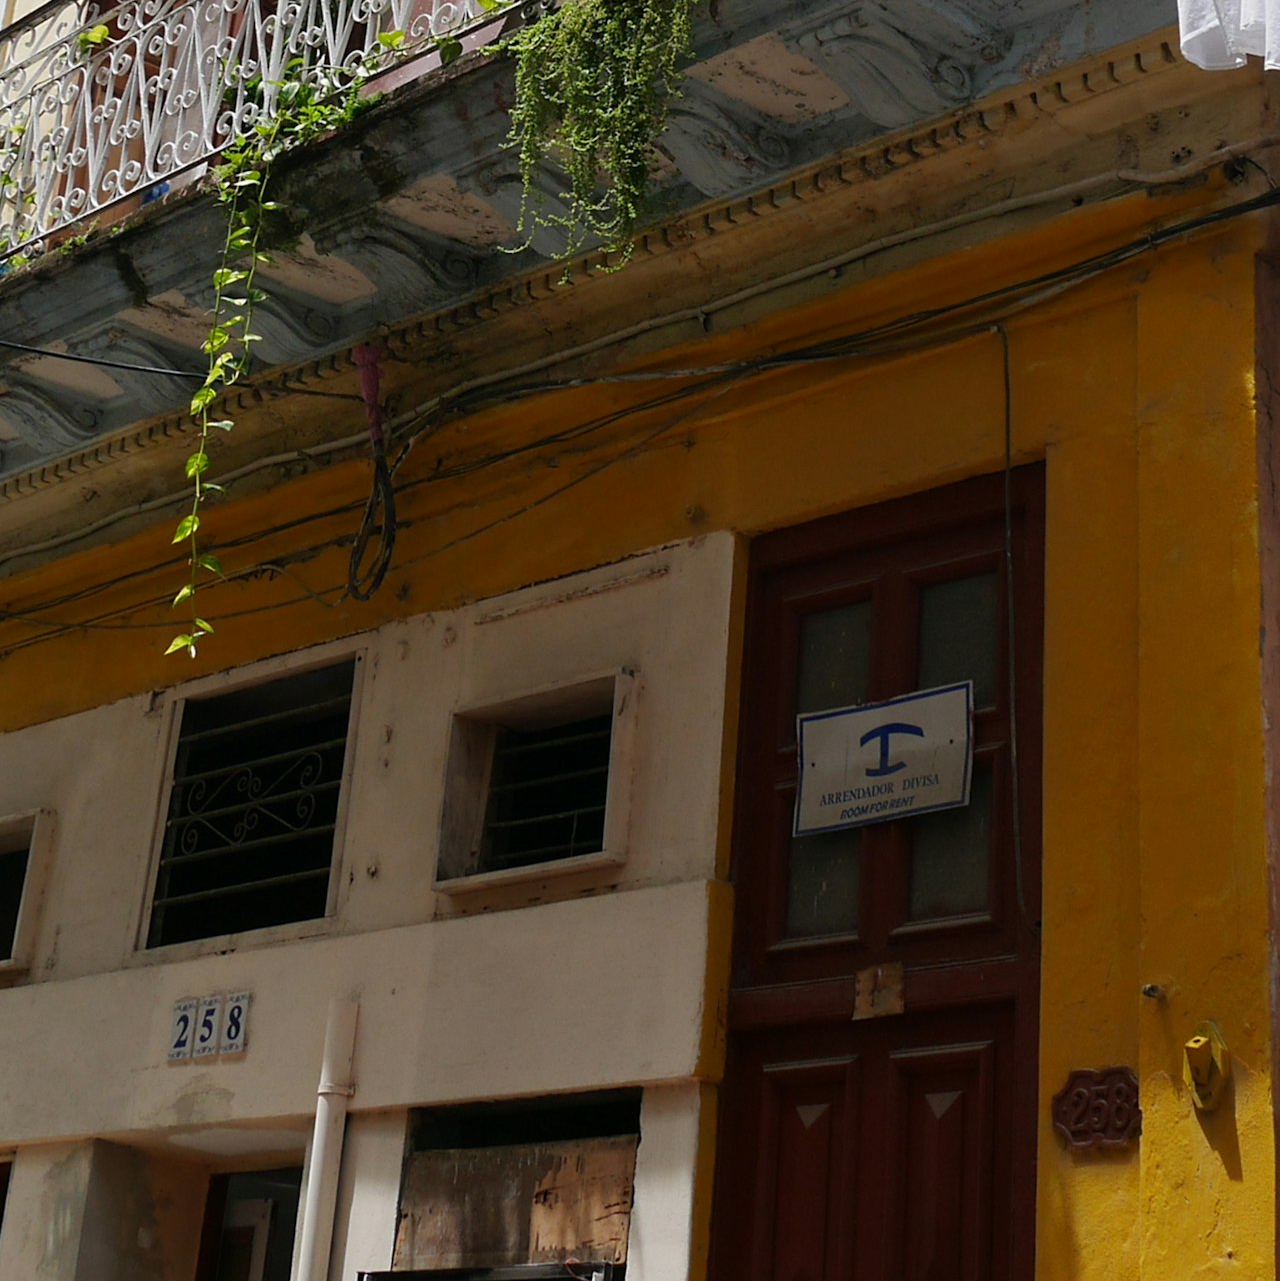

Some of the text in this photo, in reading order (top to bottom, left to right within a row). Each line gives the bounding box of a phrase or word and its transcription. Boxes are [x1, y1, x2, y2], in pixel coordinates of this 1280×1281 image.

[820, 774, 939, 806] ARRENDADOR DIVISA
[840, 796, 915, 820] ROOM FOR RENT
[173, 1005, 242, 1049] 258
[1071, 1083, 1130, 1130] 258
